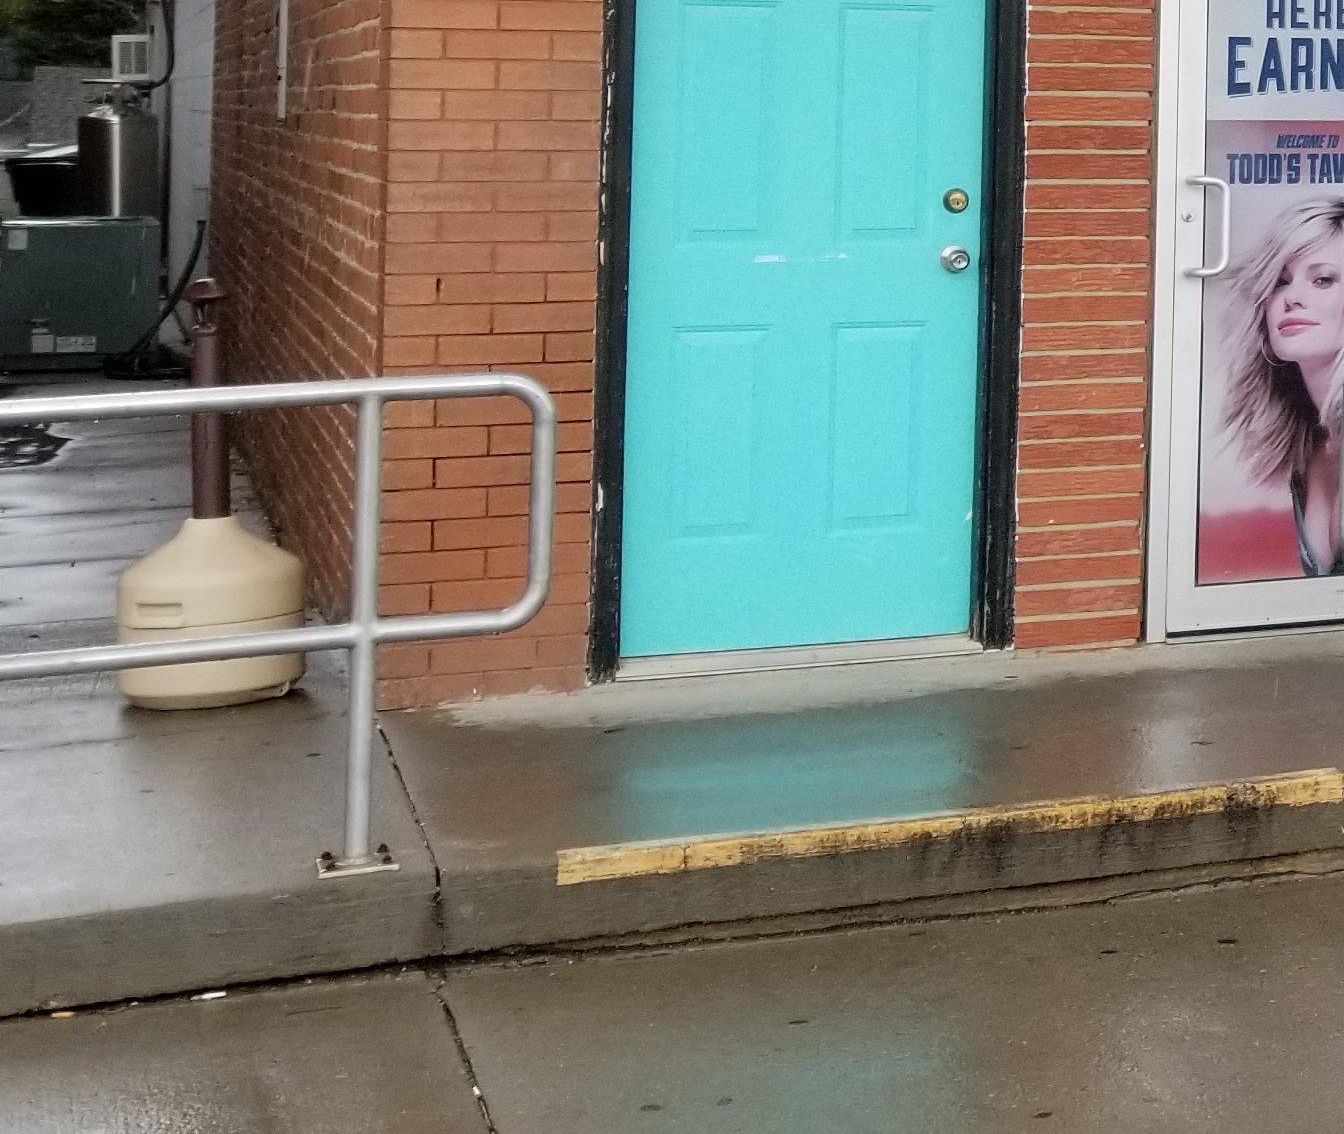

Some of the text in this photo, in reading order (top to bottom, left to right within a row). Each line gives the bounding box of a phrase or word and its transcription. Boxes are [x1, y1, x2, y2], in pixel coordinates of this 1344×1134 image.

[1276, 134, 1340, 148] WELCOME TO
[1227, 153, 1302, 184] TODD'S
